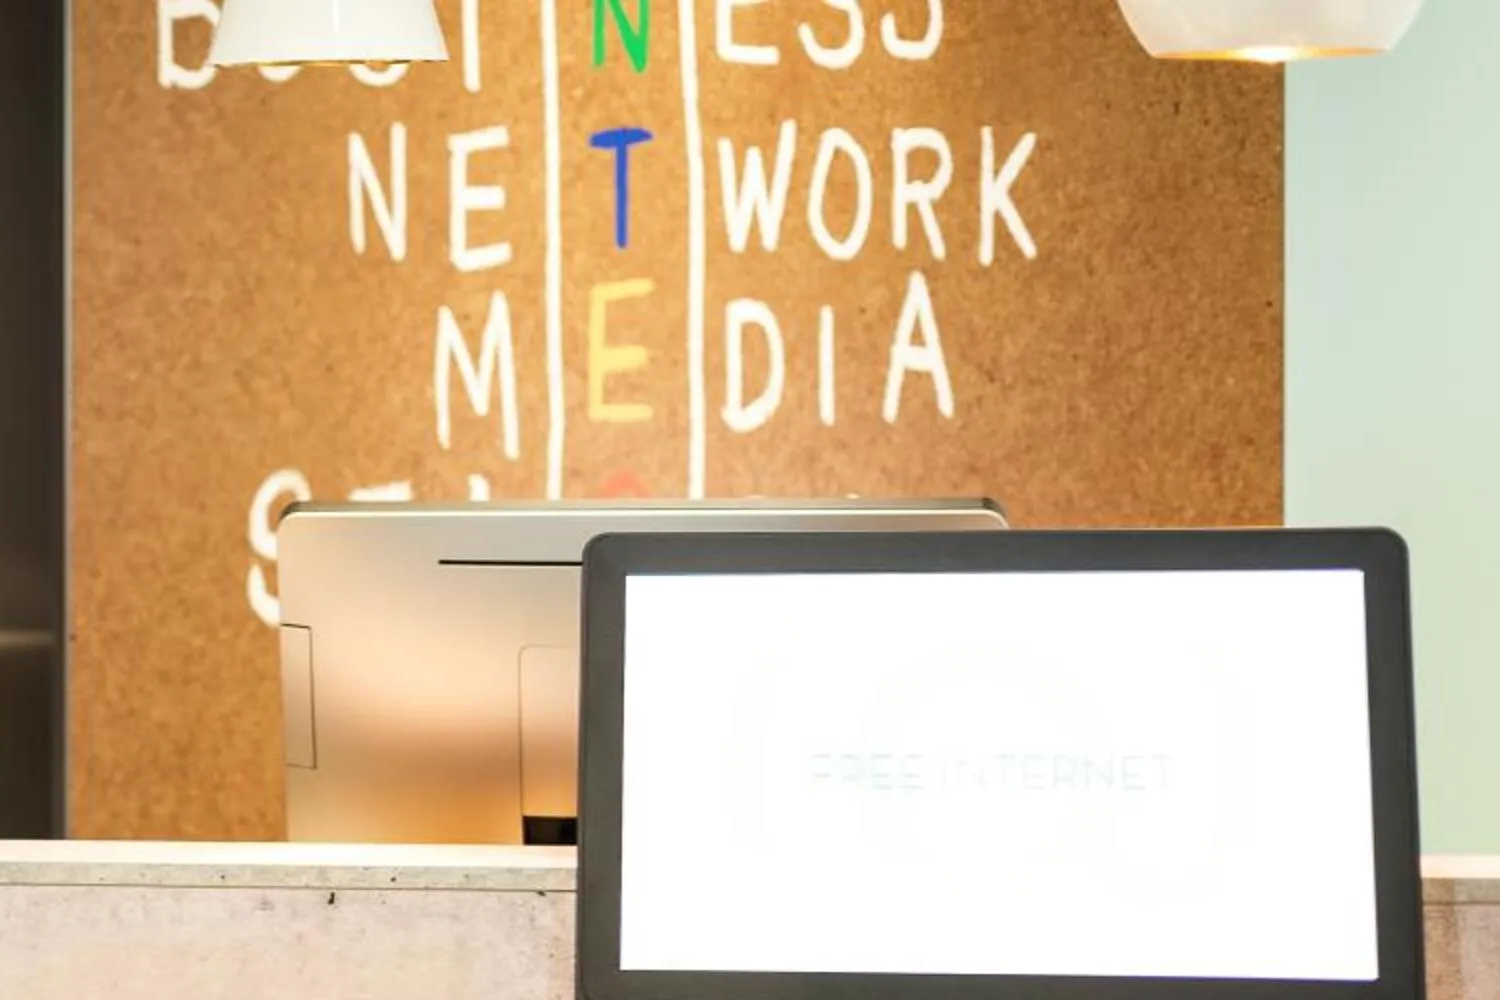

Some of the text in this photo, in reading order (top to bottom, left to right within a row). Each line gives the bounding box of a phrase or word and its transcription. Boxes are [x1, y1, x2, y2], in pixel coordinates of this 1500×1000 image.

[347, 119, 1037, 271] NETWORK
[433, 271, 955, 461] MEDIA
[808, 752, 1173, 792] FREE INTERNET
